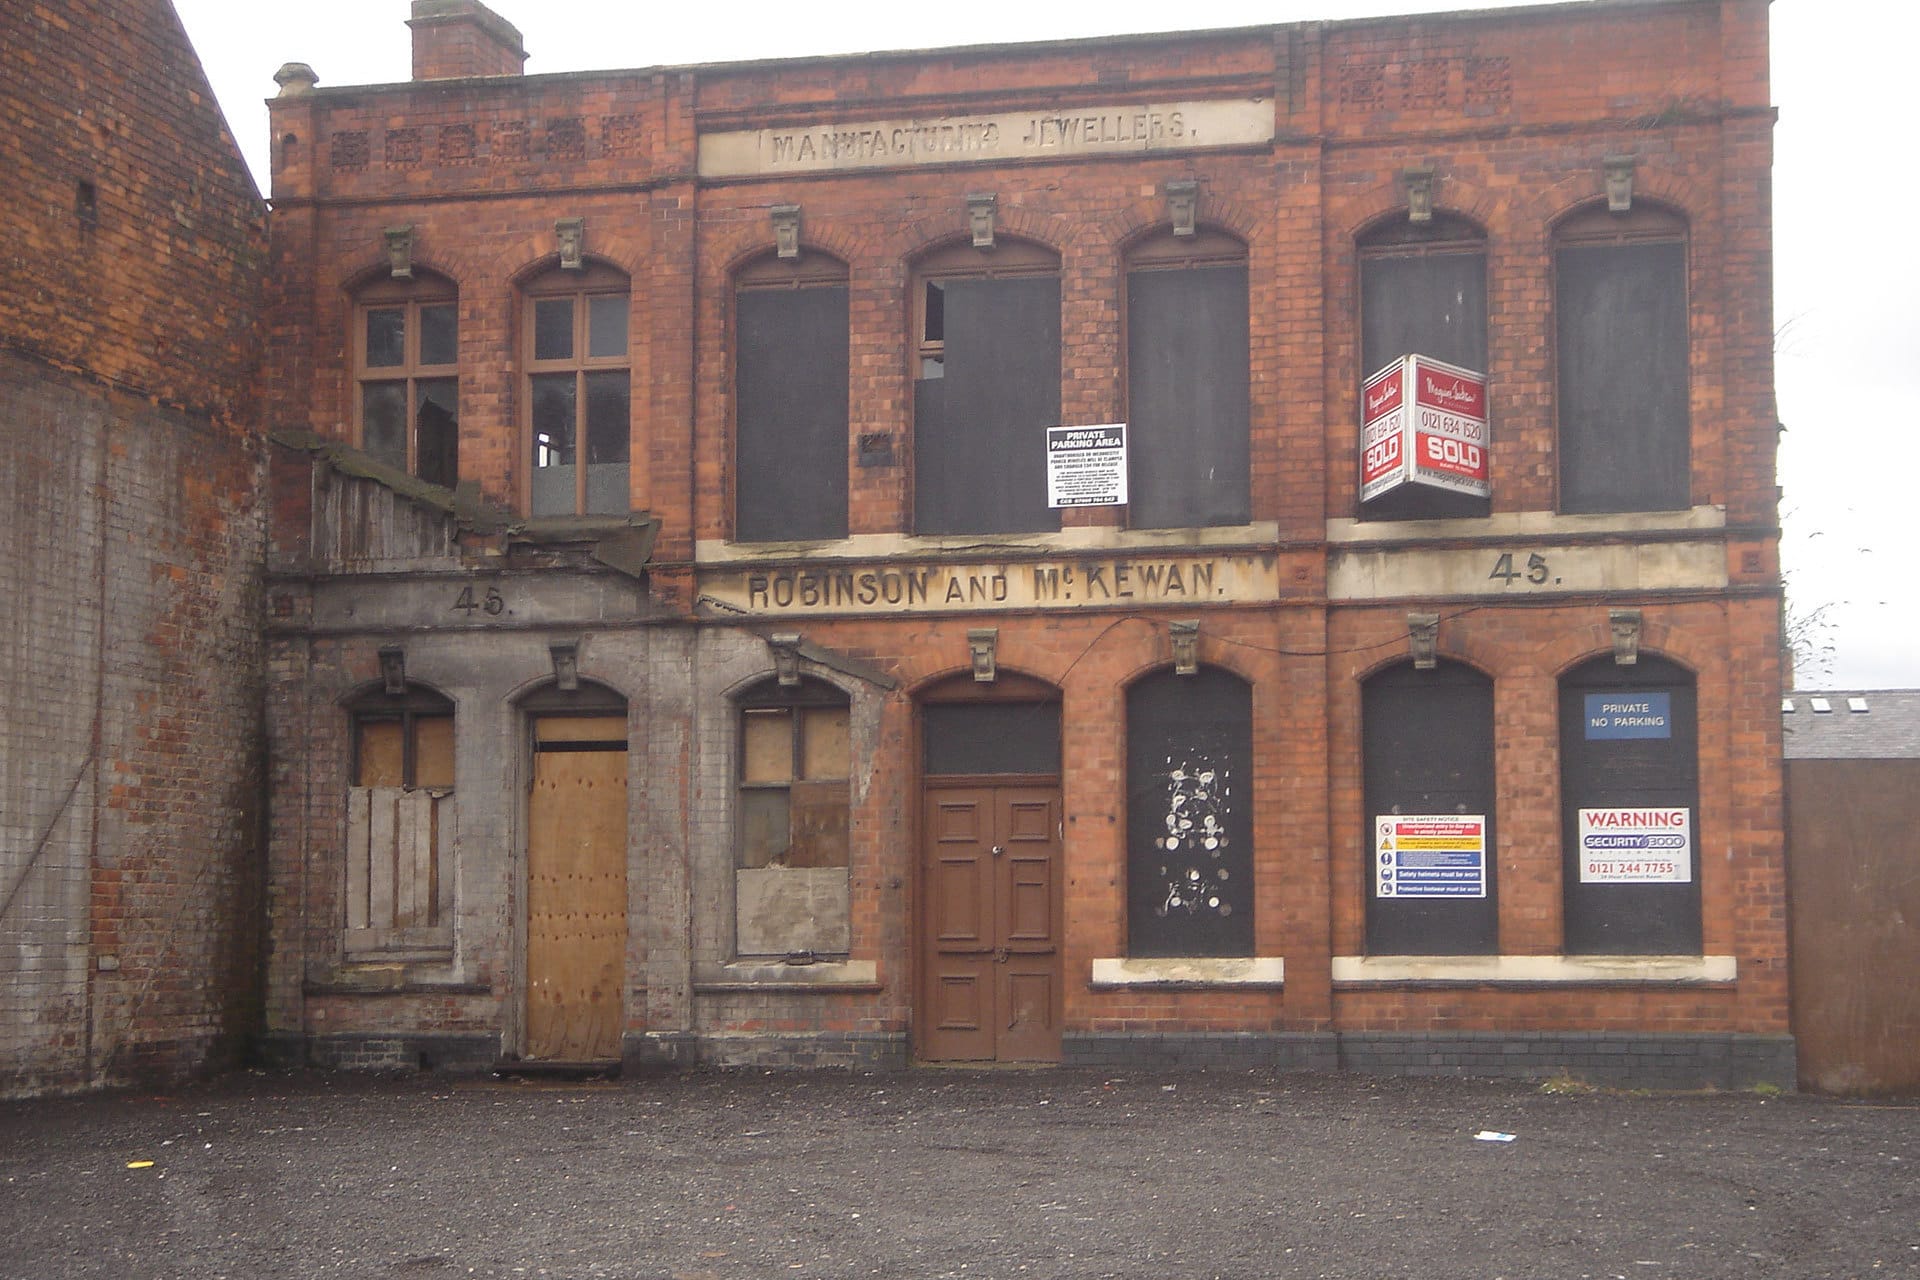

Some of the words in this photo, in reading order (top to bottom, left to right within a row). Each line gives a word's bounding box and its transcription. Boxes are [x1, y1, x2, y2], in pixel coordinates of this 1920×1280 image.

[1421, 410, 1441, 431] 0121
[1443, 416, 1460, 436] 634
[1463, 420, 1481, 441] 1520
[1066, 431, 1106, 441] PRIVATE
[1051, 440, 1094, 450] PARKING
[1094, 437, 1121, 448] AREA
[1367, 435, 1399, 473] SOLD
[1426, 436, 1481, 470] SOLD
[1487, 552, 1562, 587] 45.
[748, 571, 928, 609] ROBINSON
[945, 574, 1008, 604] AND
[1602, 703, 1650, 714] PRIVATE
[1591, 718, 1608, 728] NO
[1614, 716, 1665, 727] PARKING
[1586, 812, 1684, 827] WARNING
[1585, 836, 1641, 847] SECURITY
[1589, 863, 1614, 874] 0121
[1620, 863, 1641, 874] 244
[1644, 862, 1674, 874] 7755
